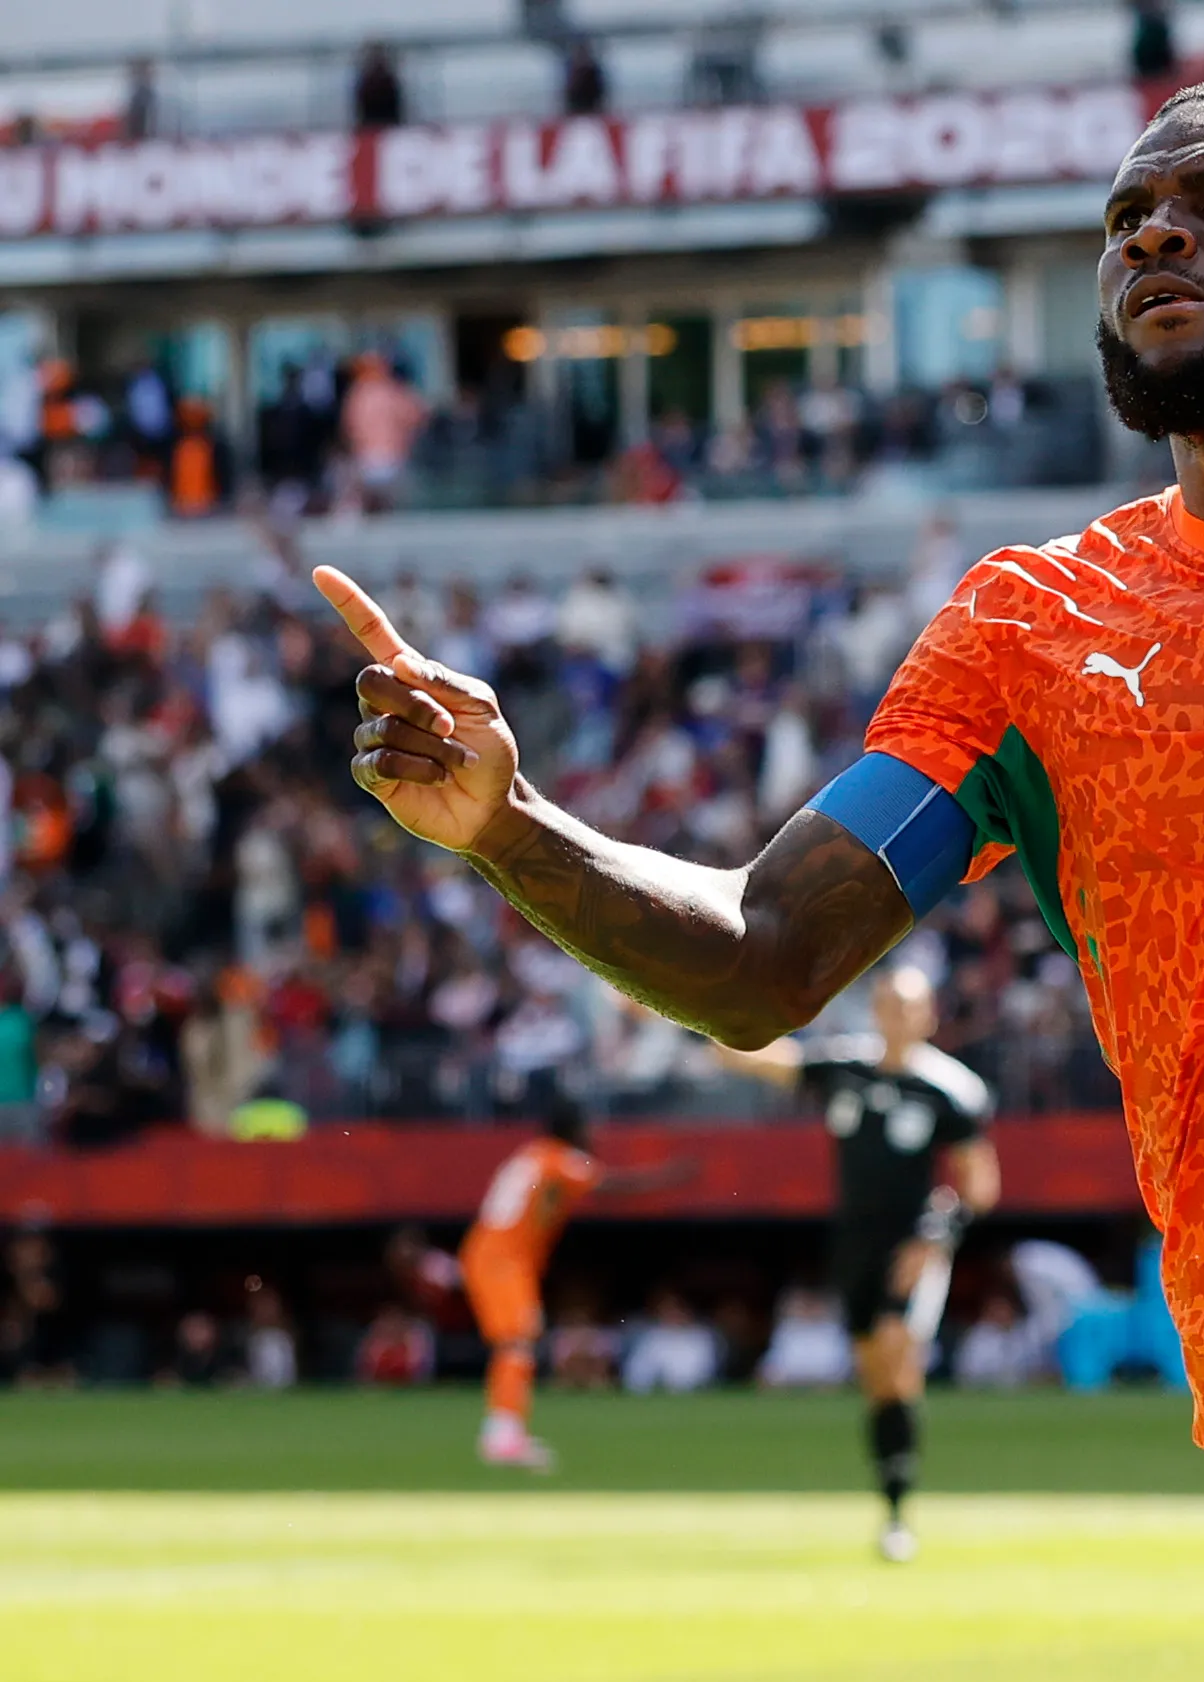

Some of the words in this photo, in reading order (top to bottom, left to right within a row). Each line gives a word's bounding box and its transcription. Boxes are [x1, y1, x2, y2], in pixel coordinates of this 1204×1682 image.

[54, 132, 352, 230] MONDE
[375, 121, 492, 214] DE
[503, 113, 623, 210] LA
[626, 102, 815, 204] FIFA
